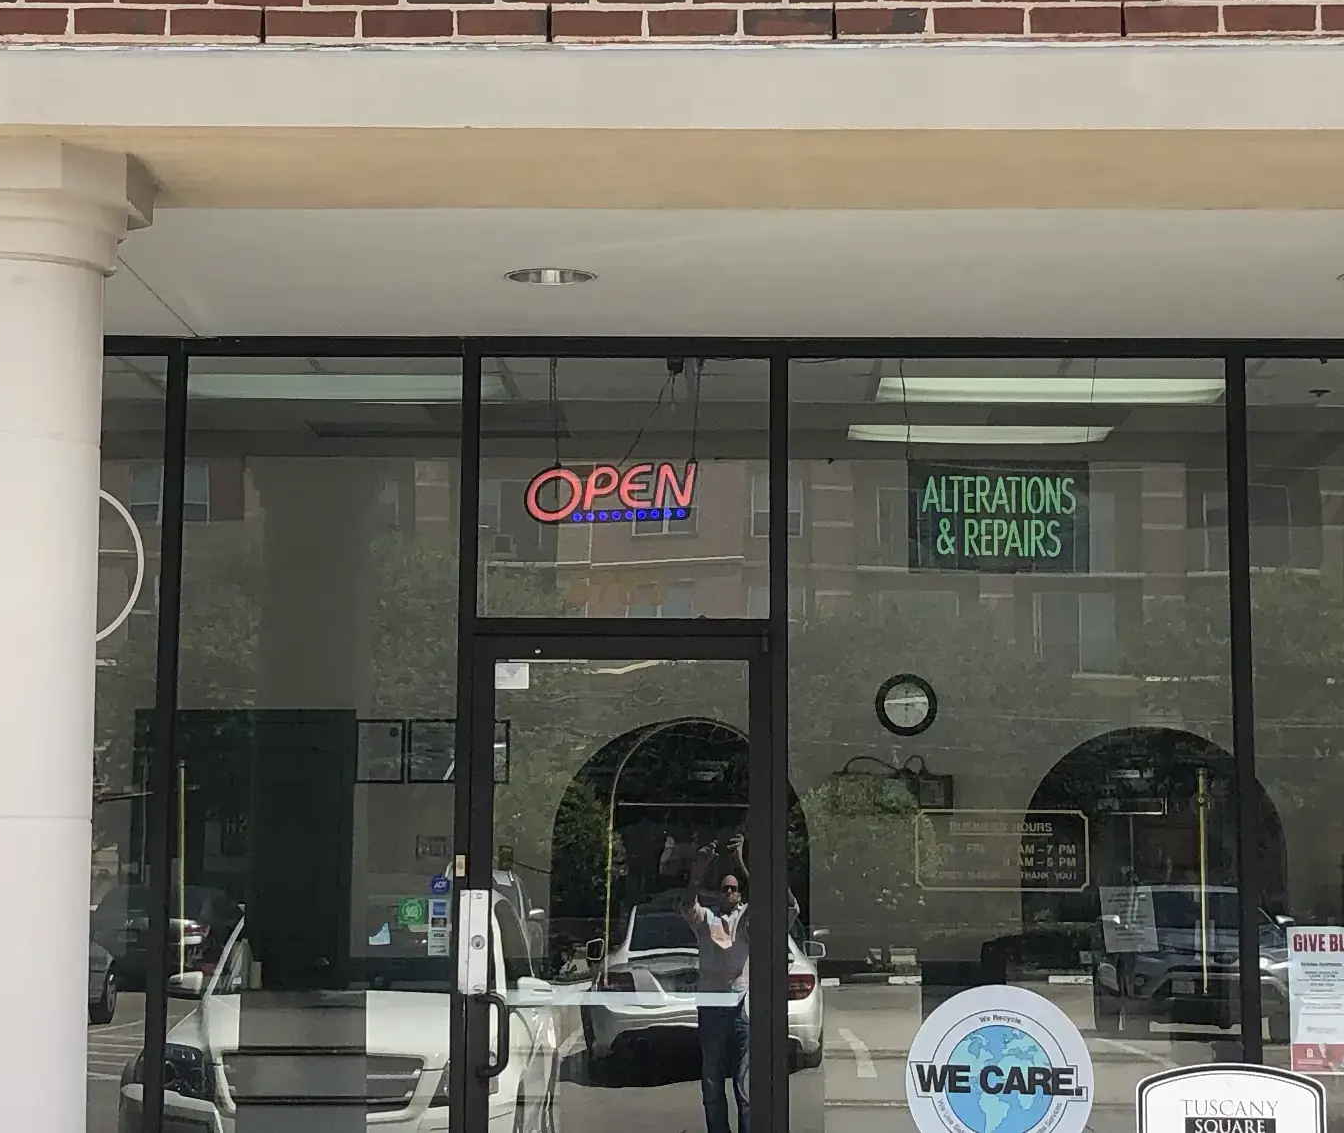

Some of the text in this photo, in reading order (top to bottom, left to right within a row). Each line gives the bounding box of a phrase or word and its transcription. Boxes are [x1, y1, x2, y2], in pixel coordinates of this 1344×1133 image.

[526, 462, 697, 522] OPEN
[922, 475, 1077, 515] ALTERATIONS
[936, 517, 1062, 558] & REPAIRS
[1012, 821, 1054, 833] HOURS
[1059, 844, 1077, 854] PM
[1016, 857, 1034, 867] AM
[1059, 857, 1077, 867] PM
[1293, 933, 1326, 953] GIVE
[915, 1064, 1084, 1097] WE CARE.
[1180, 1098, 1280, 1117] TUSCANY
[1194, 1119, 1266, 1133] SQUARE
